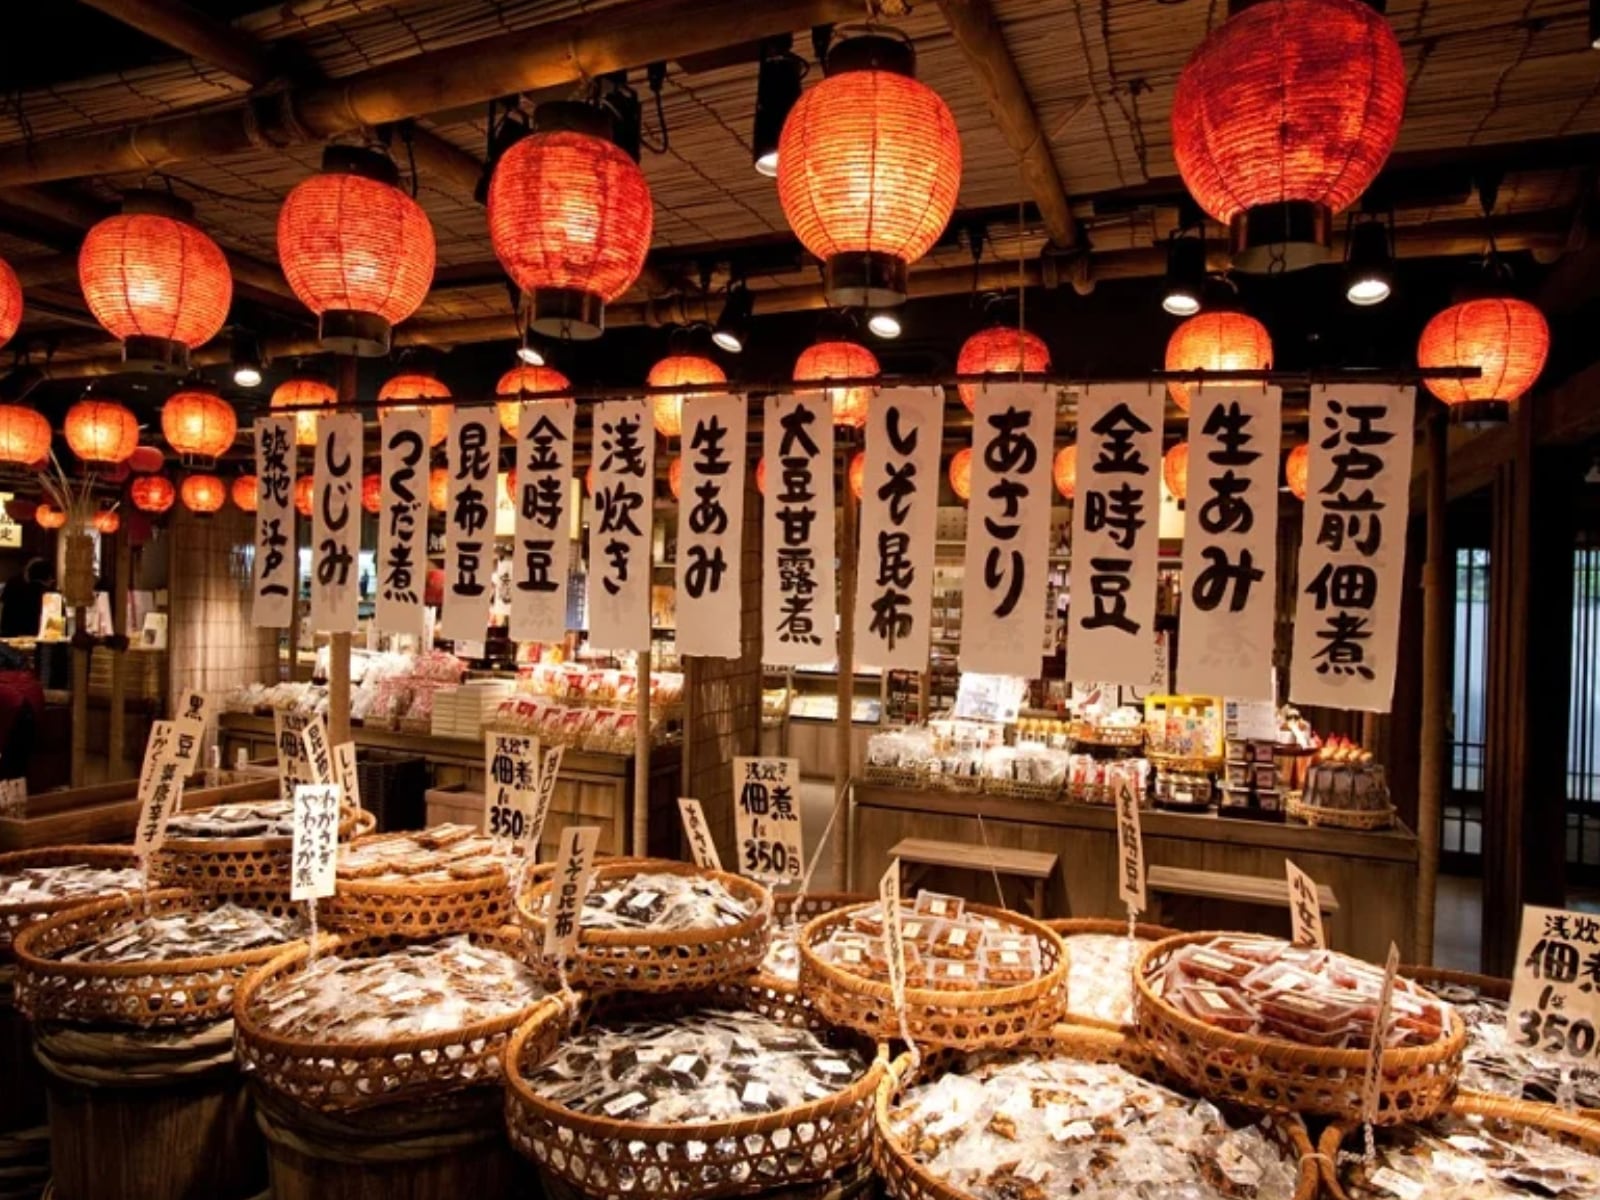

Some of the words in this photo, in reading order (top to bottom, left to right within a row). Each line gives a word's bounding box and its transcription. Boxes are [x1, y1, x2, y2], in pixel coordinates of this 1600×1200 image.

[260, 518, 289, 599] 江戸一
[316, 431, 353, 586] しじみ
[384, 429, 423, 604] つくだ煮
[452, 422, 491, 597] 昆布豆
[517, 415, 567, 592] 金時豆
[595, 413, 647, 595] 浅炊き
[685, 415, 731, 598] 生あみ
[775, 403, 822, 646] 大豆甘露煮
[870, 406, 918, 650] しそ昆布
[984, 406, 1037, 618] あさり
[1081, 403, 1152, 634] 金時豆
[1192, 401, 1264, 612] 生あみ
[1305, 400, 1397, 680] 江戸前佃煮
[490, 754, 536, 793] 佃煮
[740, 782, 798, 821] 佃煮
[745, 761, 788, 782] 浅炊き
[555, 832, 584, 938] しそ昆布
[1515, 1009, 1600, 1058] 350
